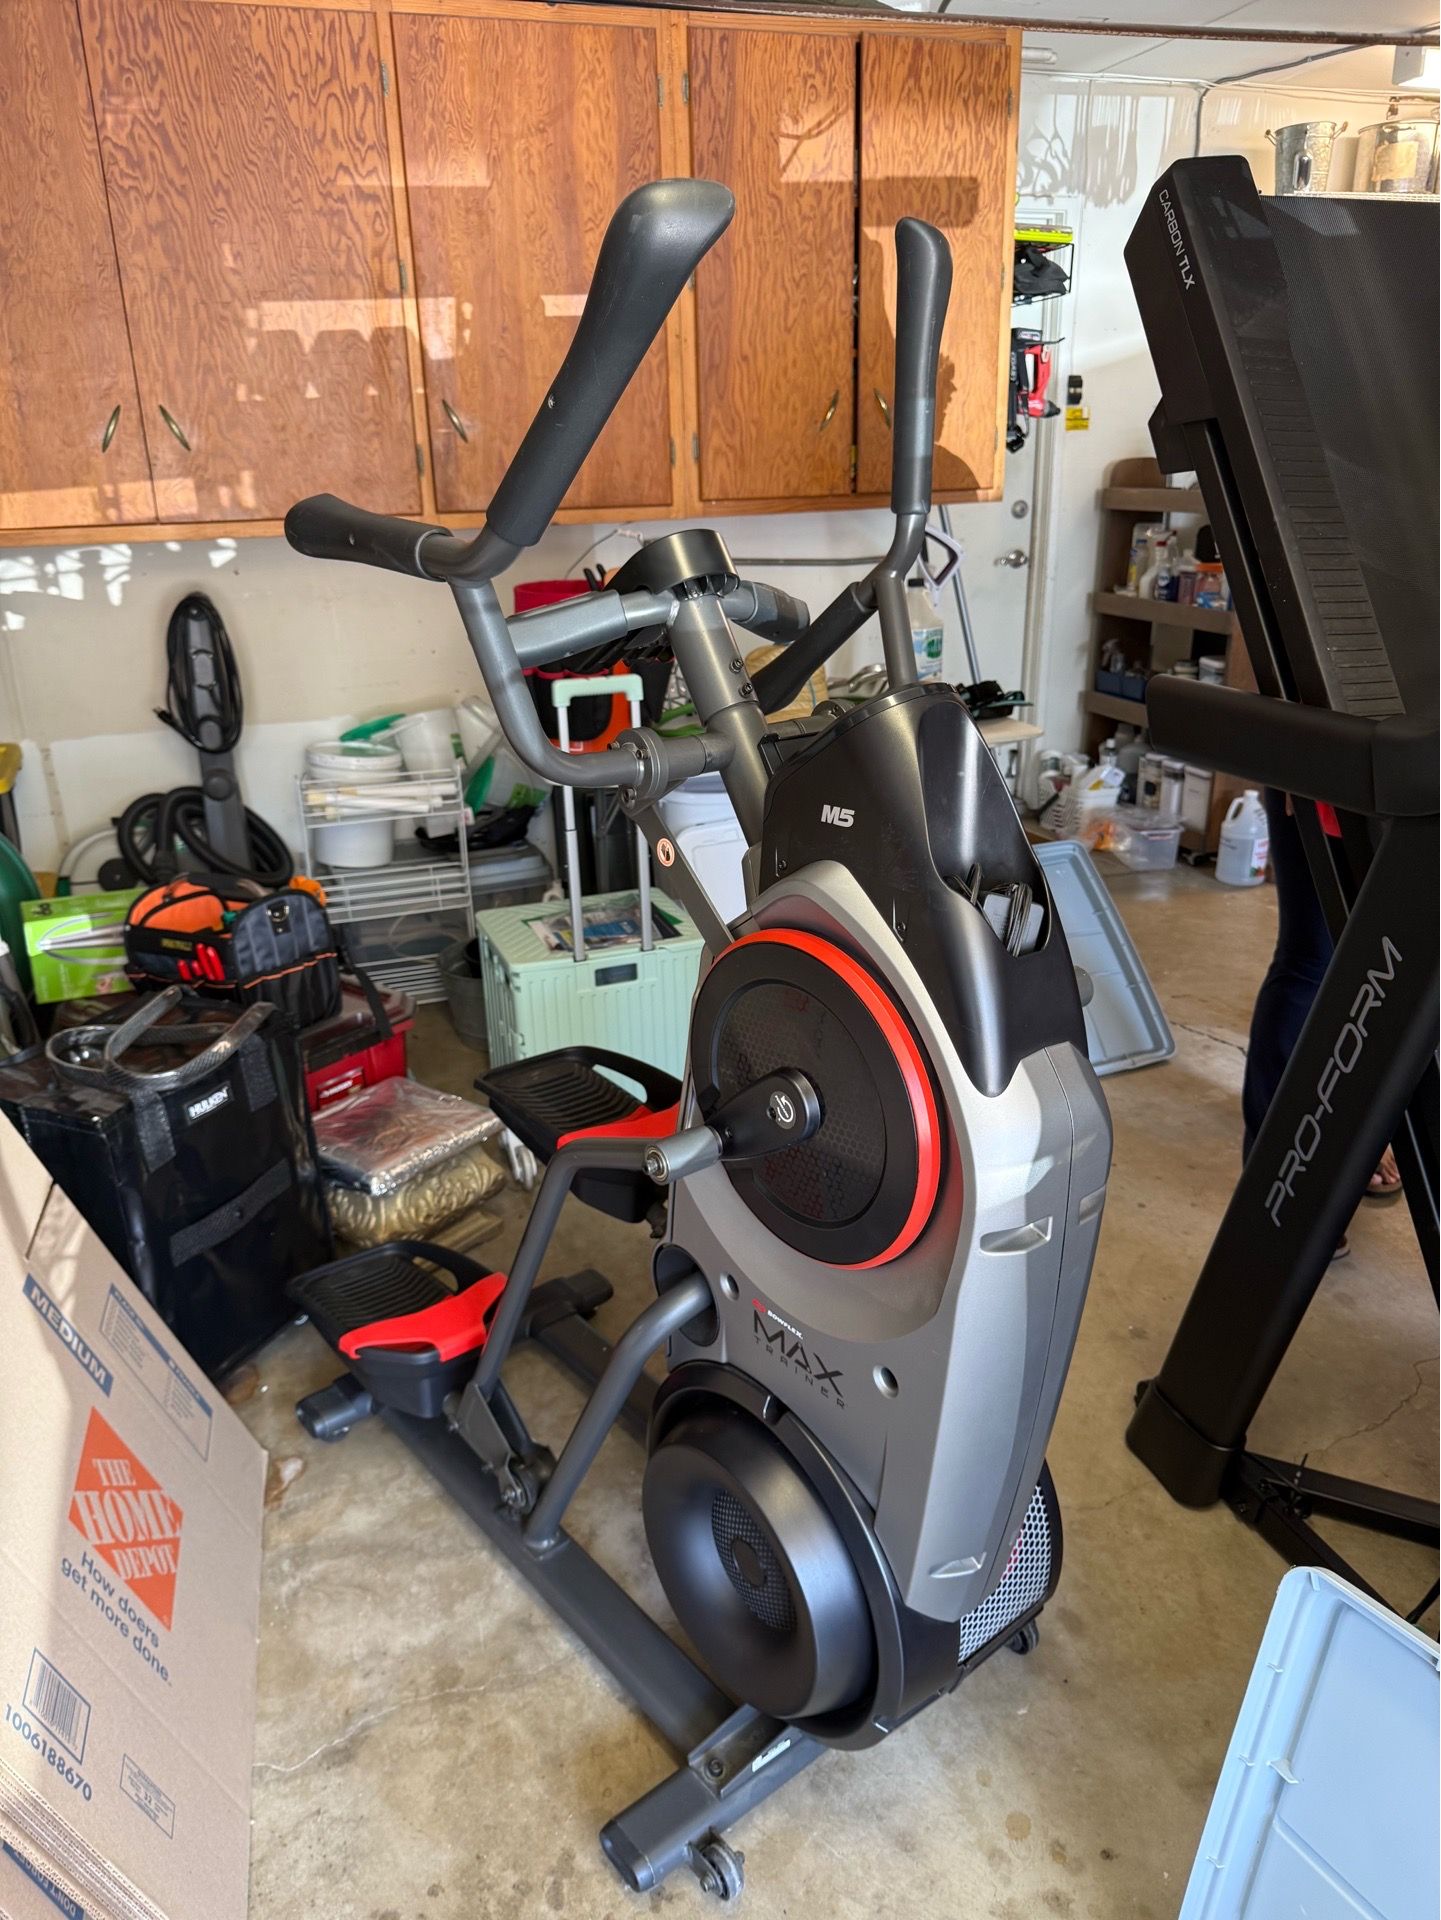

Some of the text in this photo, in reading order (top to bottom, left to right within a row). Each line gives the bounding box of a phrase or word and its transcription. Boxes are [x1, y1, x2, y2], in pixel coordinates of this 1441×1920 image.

[1159, 189, 1195, 290] CARBON TLX
[820, 804, 855, 828] M5
[1265, 936, 1403, 1227] PRO-FORM
[32, 1285, 106, 1386] MEDIUM
[754, 1309, 843, 1398] MAX
[767, 1310, 803, 1339] BOWFLEX
[754, 1335, 845, 1410] TRAINER
[92, 1458, 136, 1486] THE
[75, 1489, 180, 1546] HOME
[112, 1544, 177, 1580] DEPOT
[62, 1558, 172, 1687] get more done.
[82, 1551, 159, 1648] How doers
[5, 1703, 92, 1802] 1006188670
